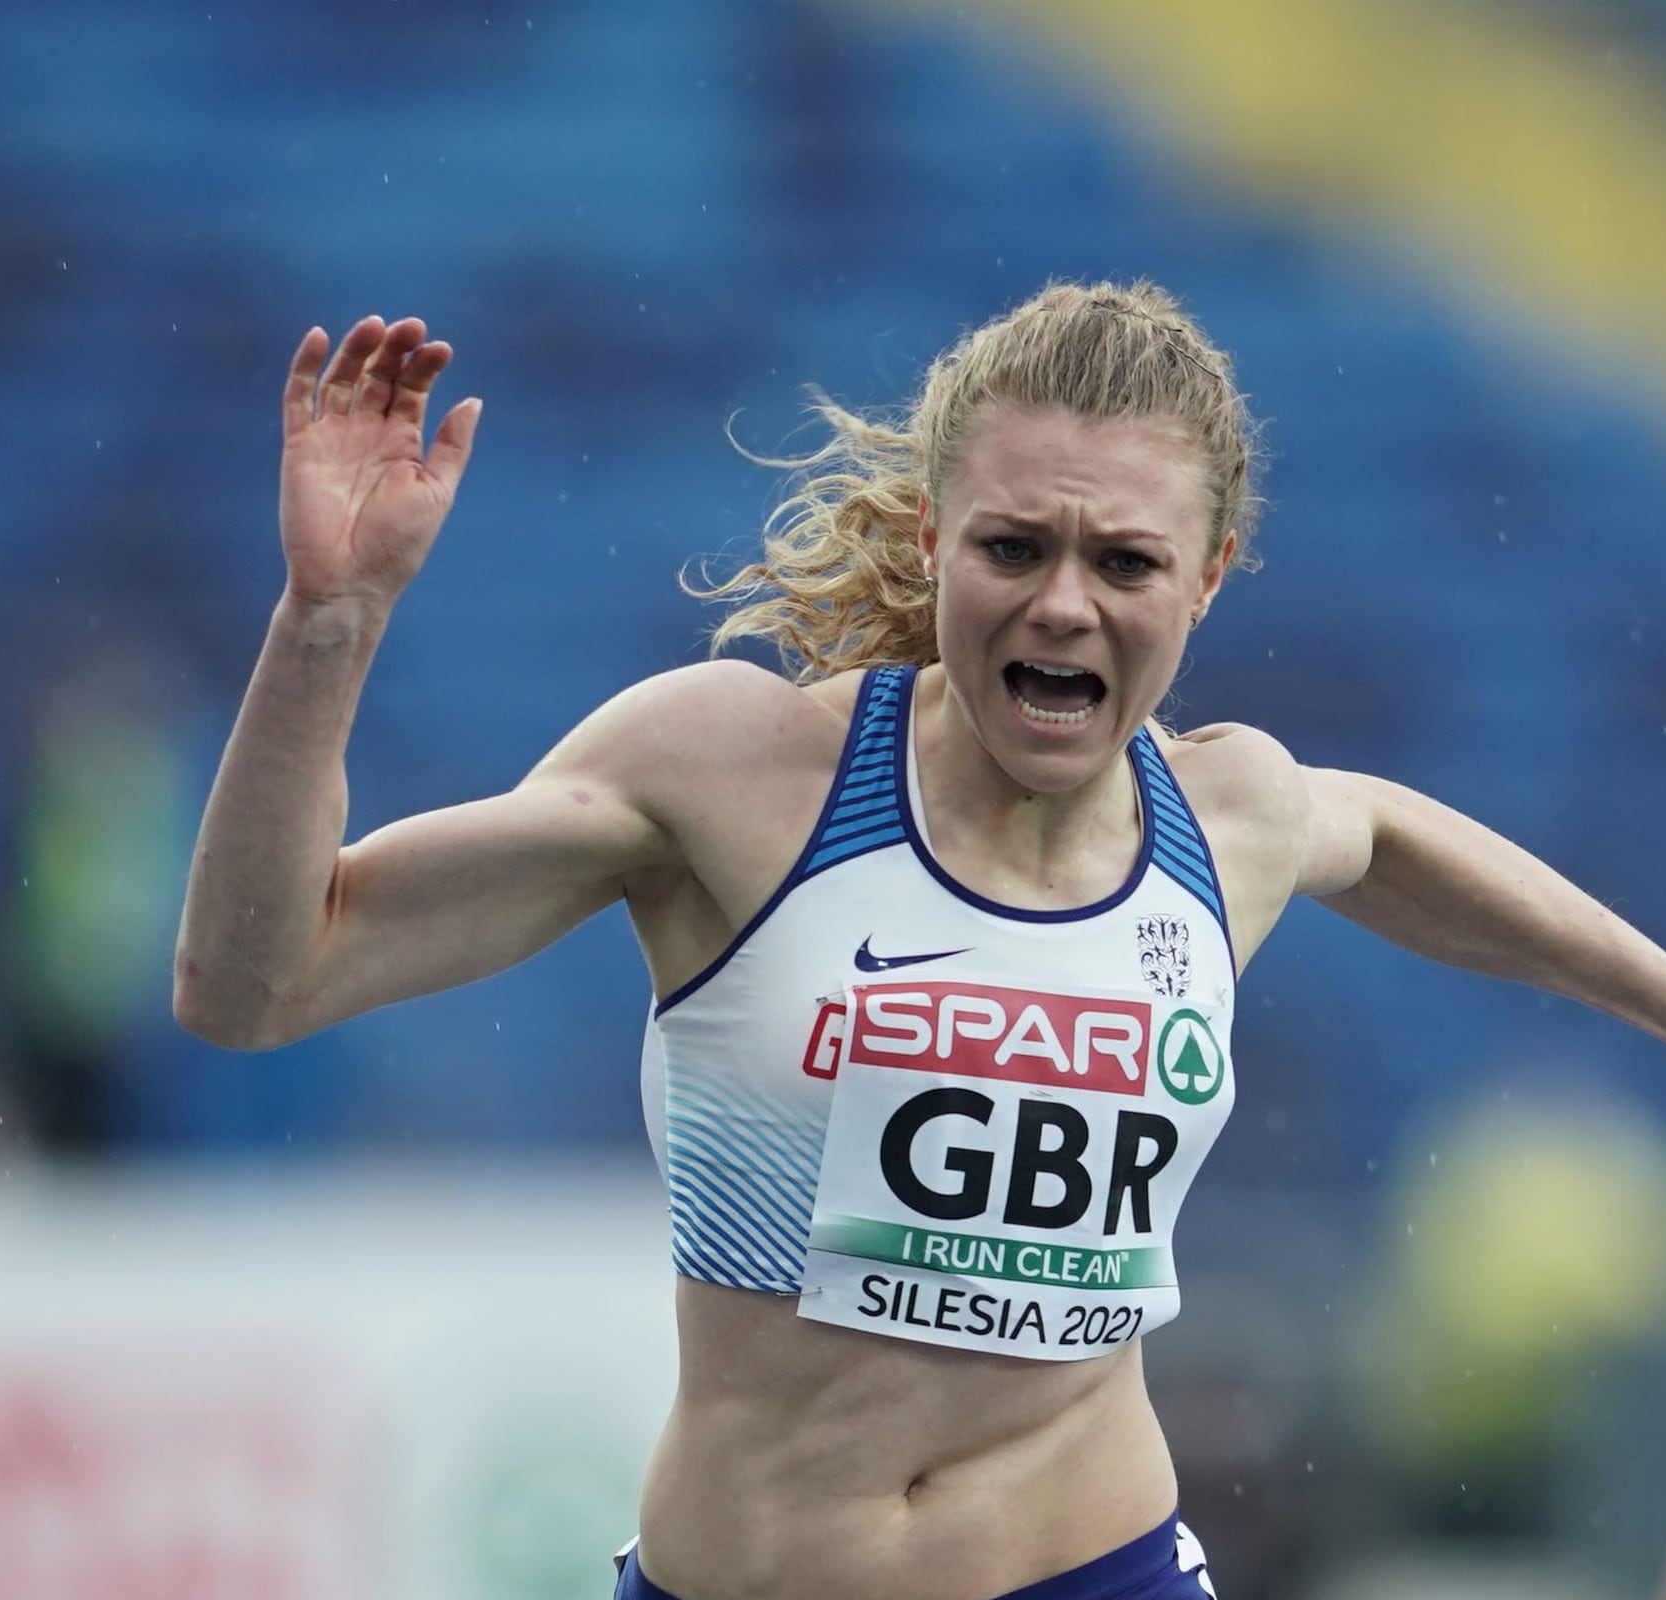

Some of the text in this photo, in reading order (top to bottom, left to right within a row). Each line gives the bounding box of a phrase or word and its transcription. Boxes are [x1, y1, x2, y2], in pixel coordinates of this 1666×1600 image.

[861, 991, 1144, 1081] SPAR
[879, 1087, 1179, 1237] GBR
[901, 1231, 914, 1261] I
[922, 1234, 1006, 1273] RUN
[856, 1273, 1144, 1346] SILESIA 2021
